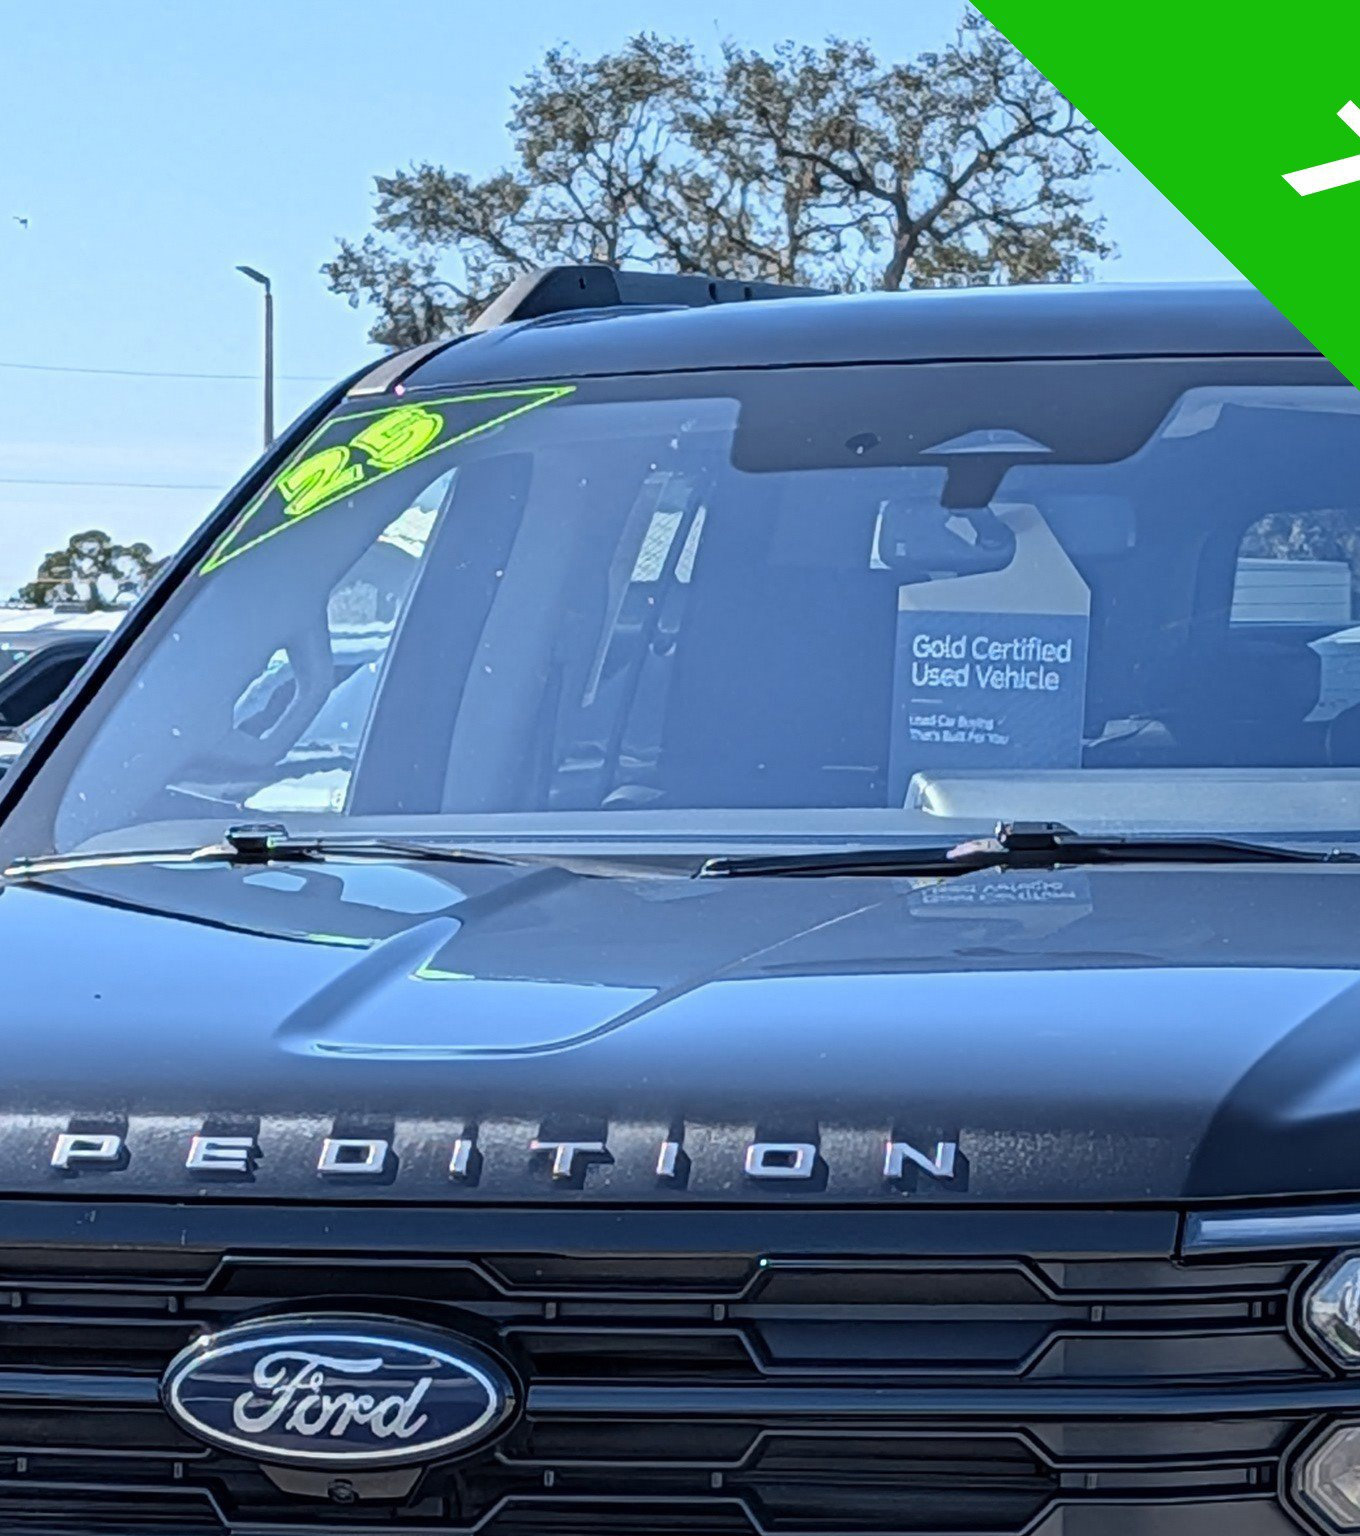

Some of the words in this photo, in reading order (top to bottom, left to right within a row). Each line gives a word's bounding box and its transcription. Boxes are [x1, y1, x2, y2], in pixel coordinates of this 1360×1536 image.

[277, 405, 444, 516] 25
[911, 661, 970, 688] Used
[975, 663, 1060, 690] Vehicle
[912, 634, 967, 659] Gold
[971, 636, 1072, 663] Certified
[233, 1351, 435, 1439] Ford
